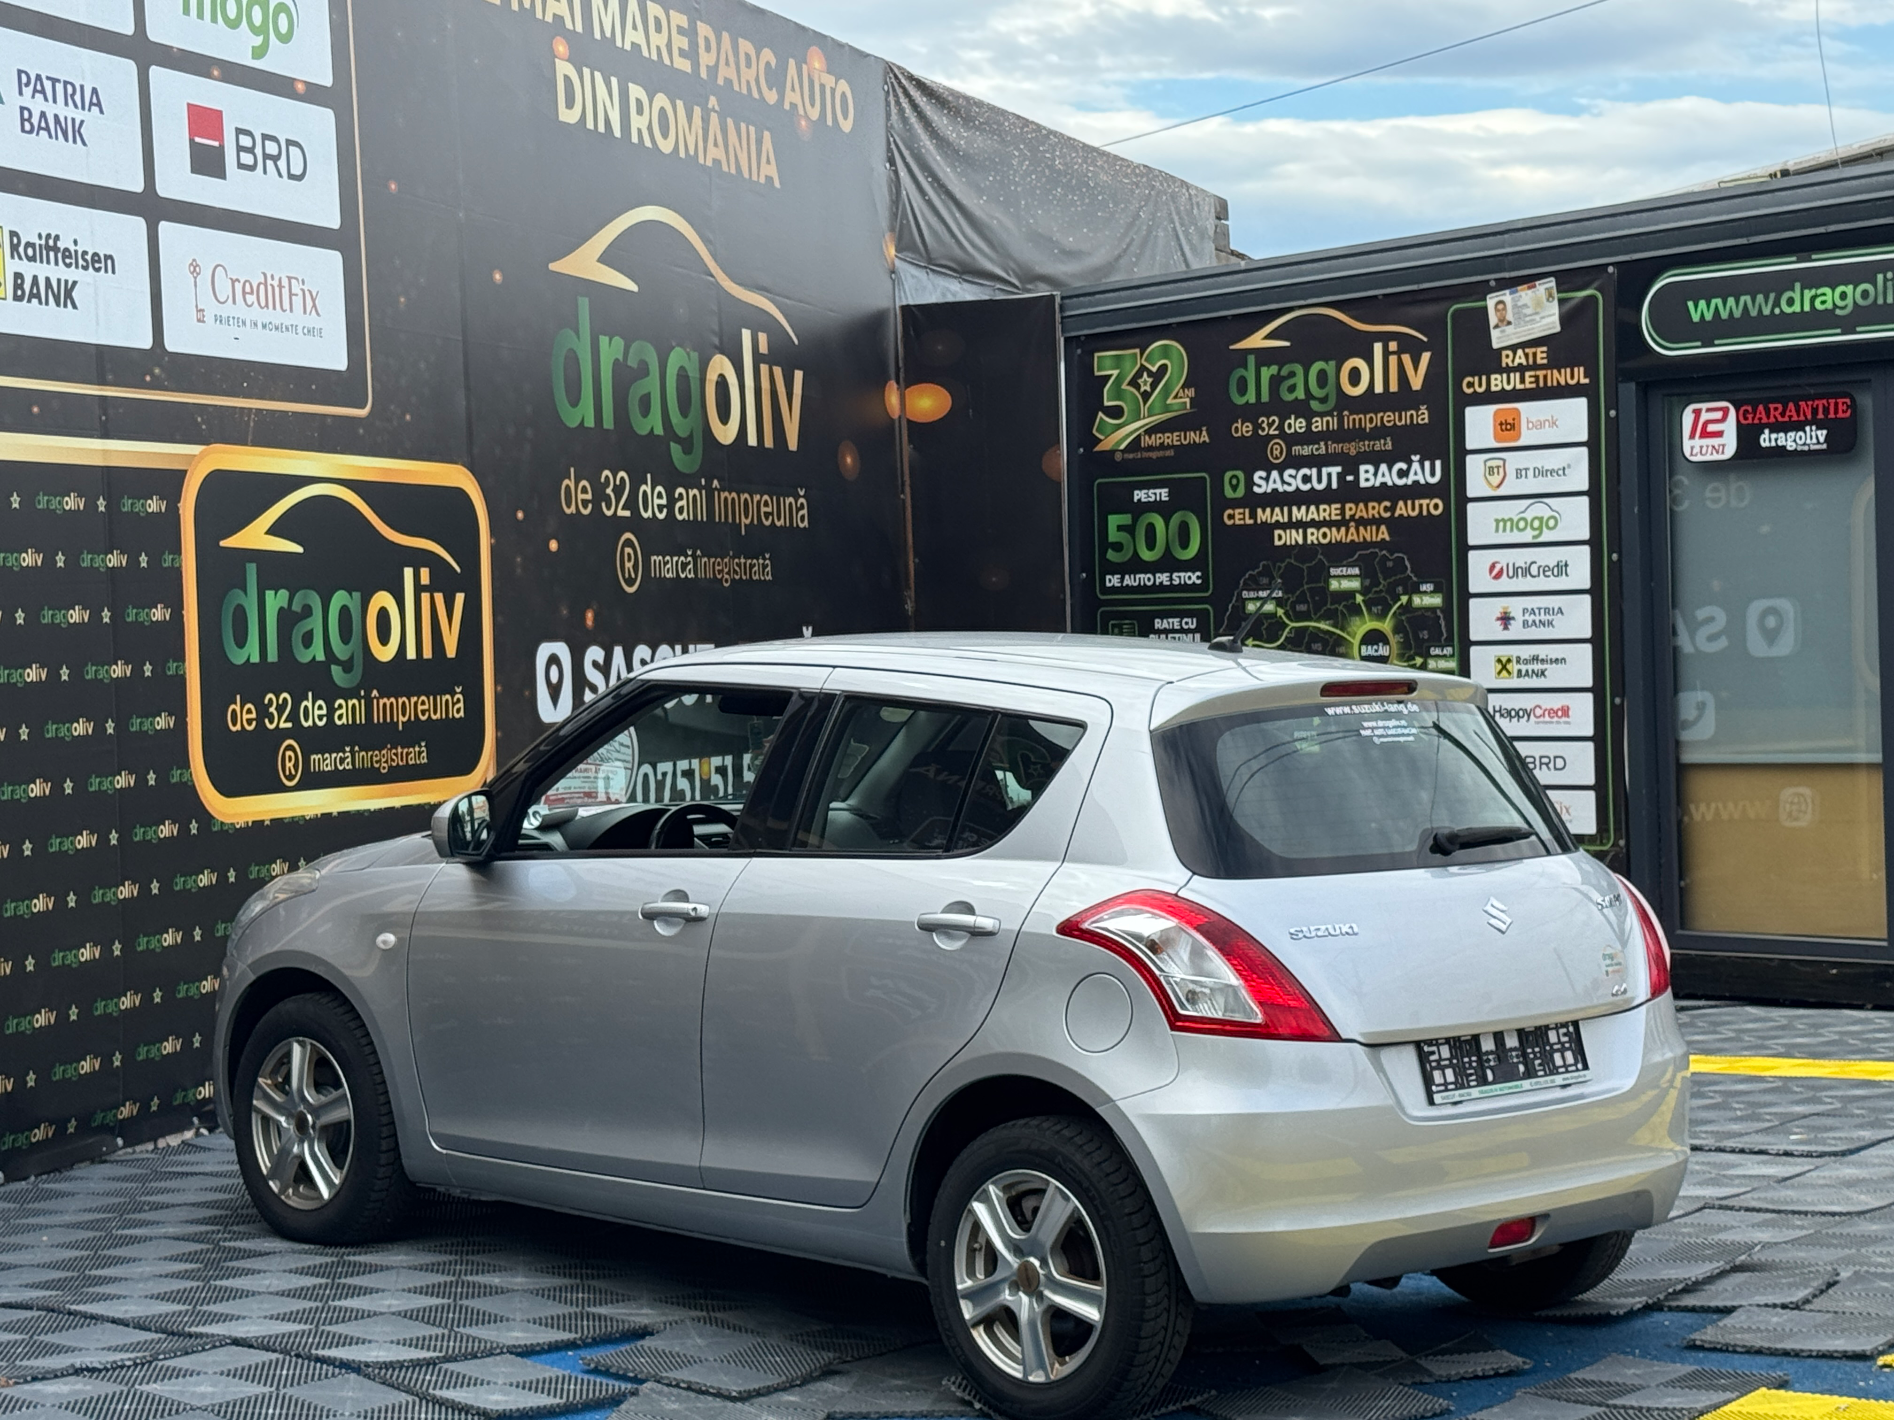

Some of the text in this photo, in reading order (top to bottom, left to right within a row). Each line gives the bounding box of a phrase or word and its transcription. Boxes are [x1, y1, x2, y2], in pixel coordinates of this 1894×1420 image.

[590, 0, 692, 74] MARE
[696, 20, 778, 105] PARC
[783, 58, 854, 133] AUTO
[16, 68, 104, 115] PATRIA
[19, 105, 88, 147] BANK
[554, 57, 780, 188] DIN ROMÂNIA
[234, 127, 308, 182] BRD
[8, 230, 116, 275] Raiffeisen
[12, 271, 79, 310] BANK
[210, 264, 321, 317] CreditFix
[213, 314, 247, 328] PRIETEN
[261, 321, 299, 336] MOMENTE
[302, 325, 324, 339] CHEIE
[1501, 346, 1548, 367] RATE
[552, 296, 803, 474] dragoliv
[1092, 340, 1190, 439] 32
[1228, 341, 1432, 412] dragoliv
[1462, 366, 1590, 395] CU BULETINUL
[1231, 404, 1429, 437] de 32 de ani împreună
[1498, 415, 1559, 433] tbi bank
[1688, 398, 1852, 440] 12 GARANTIE
[1291, 442, 1326, 457] marcă
[1327, 437, 1393, 456] înregistrată
[1689, 444, 1727, 457] LUNI
[1760, 425, 1828, 450] dragoliv
[1252, 466, 1342, 494] SASCUT
[1358, 454, 1442, 488] BACĂU
[1488, 465, 1501, 477] BT
[1515, 467, 1530, 480] BT
[35, 491, 167, 516] dragoliv dragoliv
[561, 466, 809, 536] de 32 de ani împreună
[1133, 488, 1169, 502] PESTE
[1223, 498, 1443, 525] CEL MAI MARE PARC AUTO
[1106, 510, 1201, 563] 500
[1273, 522, 1391, 546] DIN ROMÂNIA
[1493, 515, 1560, 540] mogo
[0, 548, 128, 571] ragoliv dragoliv
[651, 549, 695, 579] marcă
[696, 550, 773, 587] înregistrată
[1506, 560, 1569, 580] UniCredit
[1105, 572, 1202, 587] DE AUTO PE STOC
[40, 604, 171, 628] dragoliv dragoliv
[221, 562, 466, 689] dragoliv
[1154, 617, 1197, 630] RATE CU
[1522, 606, 1564, 617] PATRIA
[1522, 618, 1555, 629] BANK
[84, 660, 132, 683] dragoliv
[1515, 654, 1567, 666] Raiffeisen
[1516, 668, 1547, 679] BANK
[227, 686, 465, 732] de 32 de ani împreună
[1493, 704, 1571, 723] HappyCredit
[44, 712, 175, 741] dragoliv dragoliv
[310, 746, 352, 773] marcă
[355, 741, 428, 773] înregistrată
[1525, 755, 1567, 771] BRD
[0, 778, 51, 803] dragoliv
[88, 770, 136, 794] dragoliv
[48, 830, 98, 854] dragoliv
[132, 820, 179, 843] dragoliv
[2, 859, 289, 918] dragoliv dragoliv dragoliv dragoliv
[1288, 923, 1359, 940] SUZUKI
[51, 928, 183, 967] dragoliv dragoliv
[4, 975, 220, 1034] dragoliv dragoliv dragoliv
[51, 1036, 182, 1080] dragoliv dragoliv
[1, 1122, 56, 1151] dragoliv
[91, 1101, 140, 1127] dragoliv
